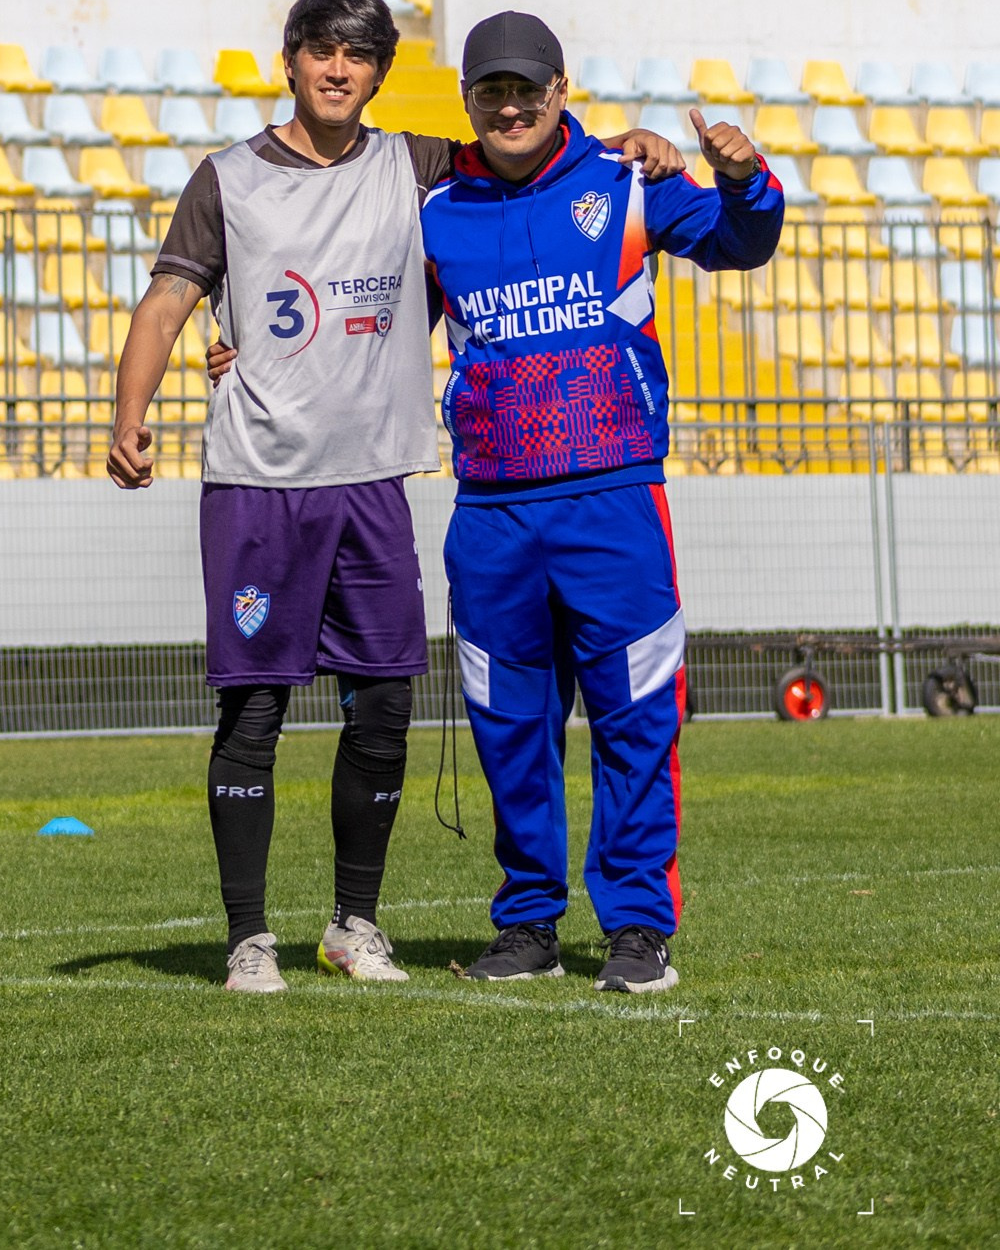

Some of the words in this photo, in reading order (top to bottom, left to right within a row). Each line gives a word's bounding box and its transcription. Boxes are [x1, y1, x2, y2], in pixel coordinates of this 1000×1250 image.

[328, 275, 402, 296] TERCERA
[457, 271, 603, 321] MUNICIPAL
[266, 289, 305, 339] 3
[469, 299, 605, 347] MEJILLONES
[216, 785, 264, 798] FRC
[374, 789, 401, 802] FR
